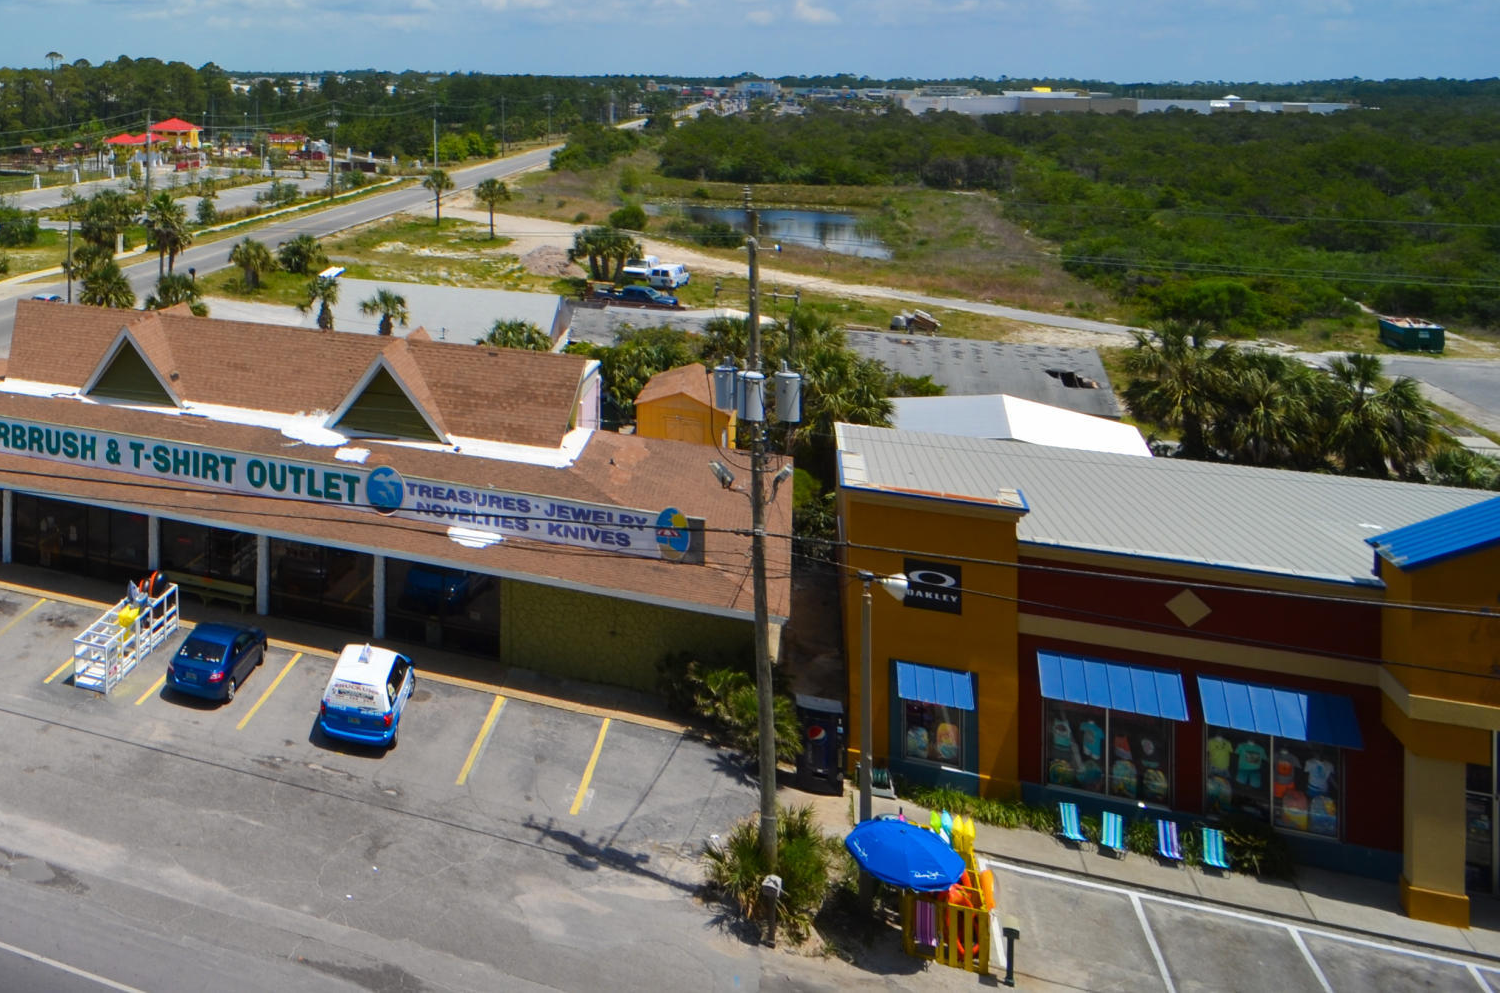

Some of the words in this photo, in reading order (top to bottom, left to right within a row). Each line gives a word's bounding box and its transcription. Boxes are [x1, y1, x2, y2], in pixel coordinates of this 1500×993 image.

[105, 438, 121, 465] &
[129, 442, 236, 484] T-SHIRT
[246, 459, 360, 504] OUTLET
[406, 481, 532, 513] TREASURES
[544, 505, 648, 532] JEWELRY
[416, 501, 530, 532] NOVELTIES
[547, 522, 631, 547] KNIVES
